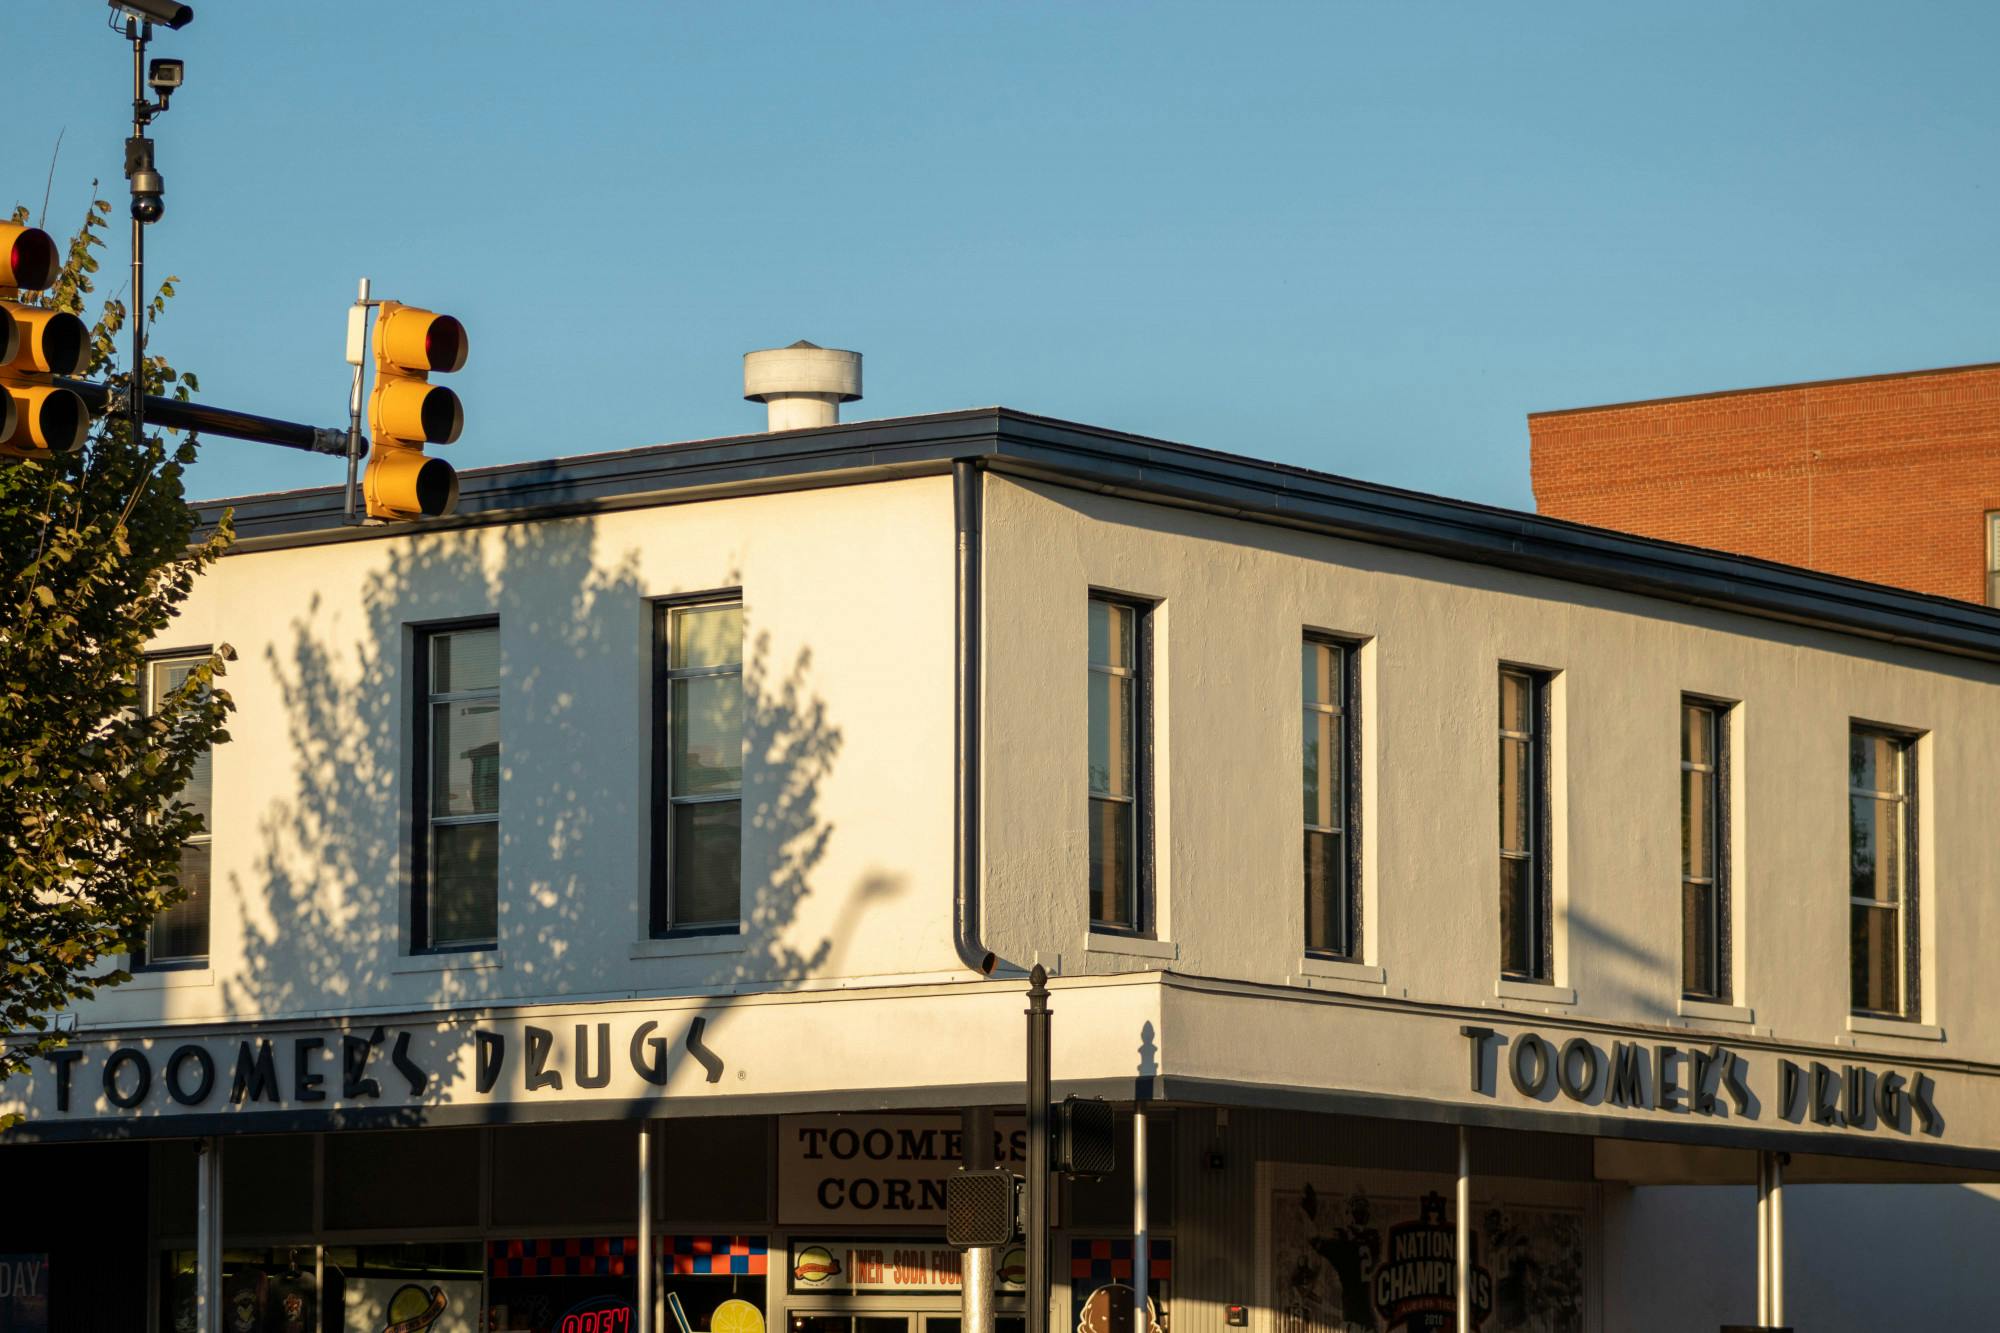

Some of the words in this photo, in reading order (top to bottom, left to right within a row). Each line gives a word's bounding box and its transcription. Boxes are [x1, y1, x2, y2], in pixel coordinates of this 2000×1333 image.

[46, 1026, 428, 1112] TOOMER'S
[475, 1016, 725, 1094] DRUGS
[1459, 1024, 1750, 1116] TOOMER'S
[1777, 1057, 1934, 1134] DRUGS
[817, 1177, 948, 1211] CORN
